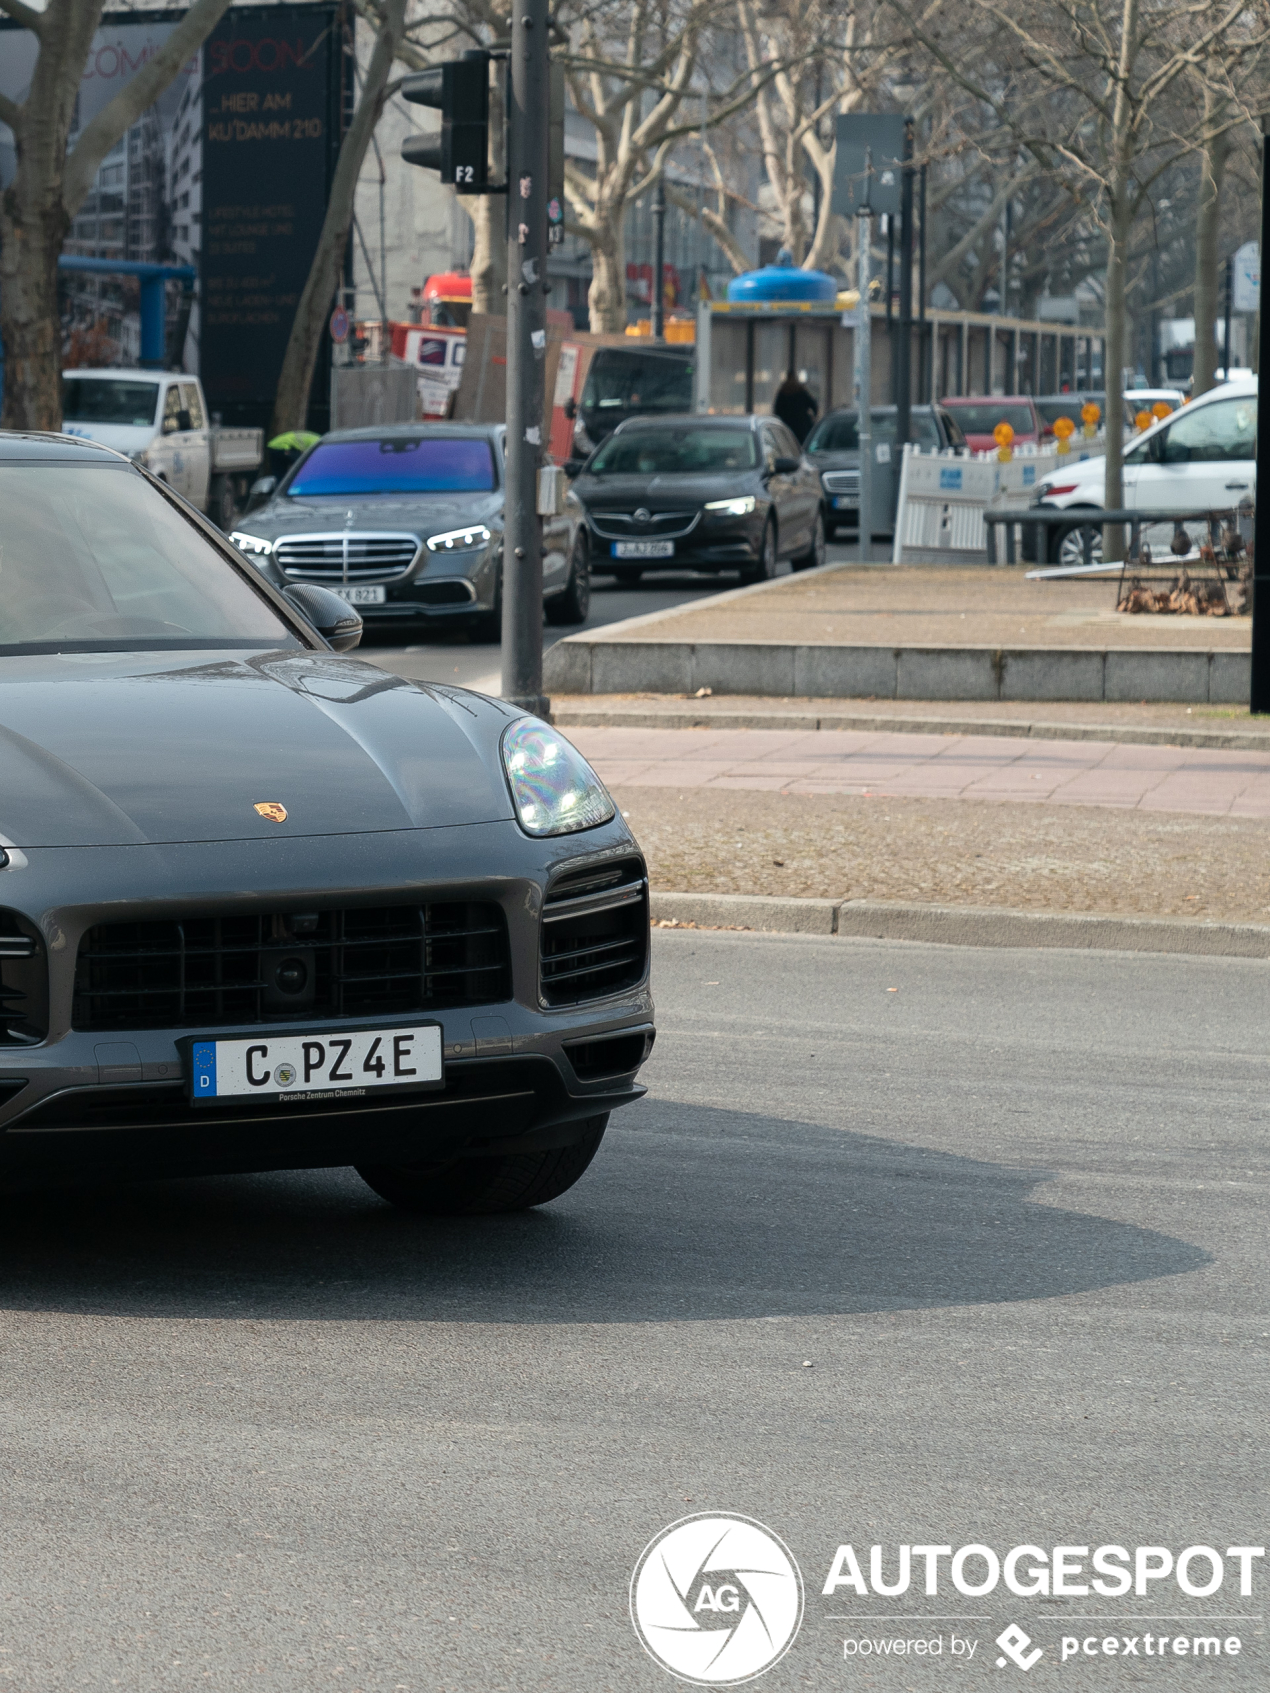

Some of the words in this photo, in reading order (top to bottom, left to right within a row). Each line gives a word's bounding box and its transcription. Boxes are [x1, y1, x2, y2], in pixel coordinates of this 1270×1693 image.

[263, 91, 292, 111] AM
[293, 117, 323, 139] 210
[455, 165, 475, 183] F2
[245, 1044, 271, 1087] C
[199, 1075, 210, 1088] D
[279, 1092, 306, 1101] Porsche
[306, 1090, 334, 1100] Zentrum
[335, 1088, 366, 1098] Chemnitz
